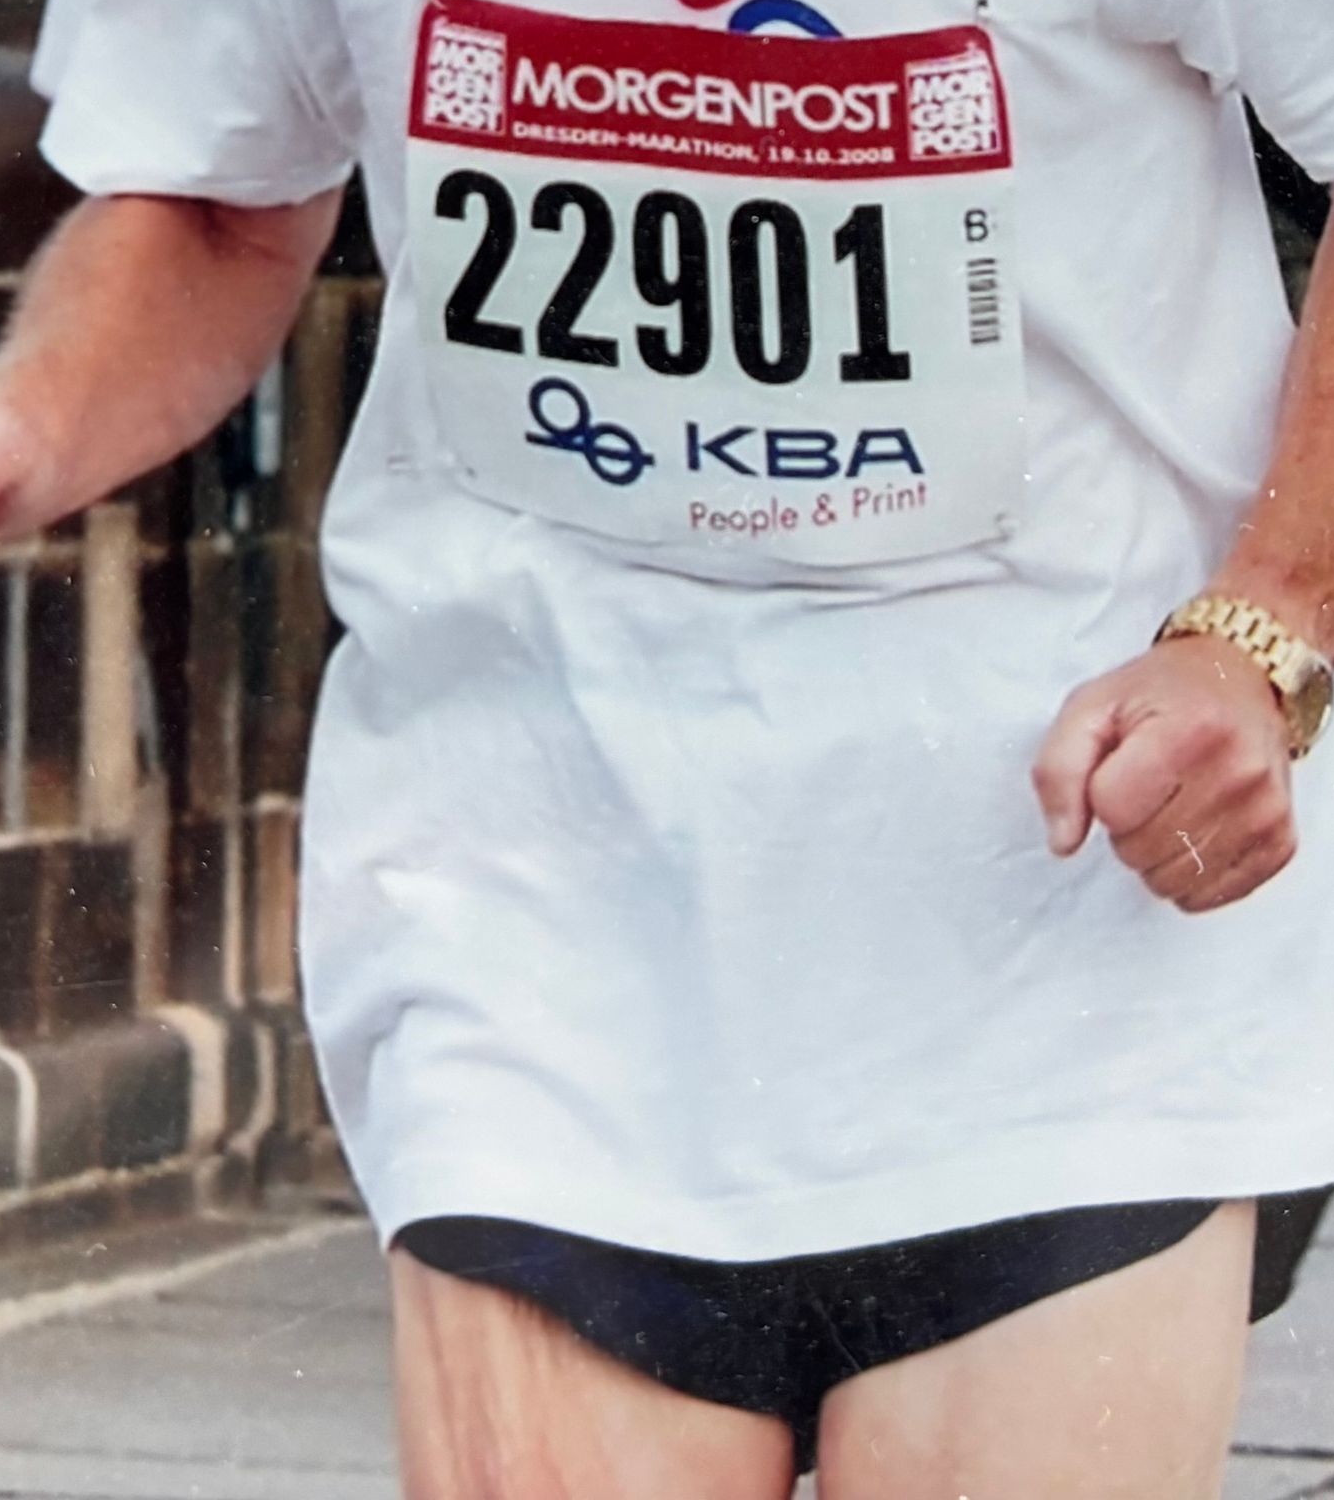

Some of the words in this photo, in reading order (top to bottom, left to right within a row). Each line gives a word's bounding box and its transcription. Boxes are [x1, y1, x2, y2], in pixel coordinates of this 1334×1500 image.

[431, 37, 504, 72] MOR
[428, 67, 503, 102] GEN
[511, 55, 898, 132] MORGENPOST
[911, 70, 992, 104] MOR
[424, 97, 503, 131] POST
[911, 95, 995, 128] GEN
[912, 123, 997, 156] POST
[965, 209, 988, 241] B
[434, 168, 911, 385] 22901
[686, 421, 925, 479] KBA
[690, 496, 799, 536] People
[812, 493, 836, 526] &
[853, 482, 926, 517] Print
